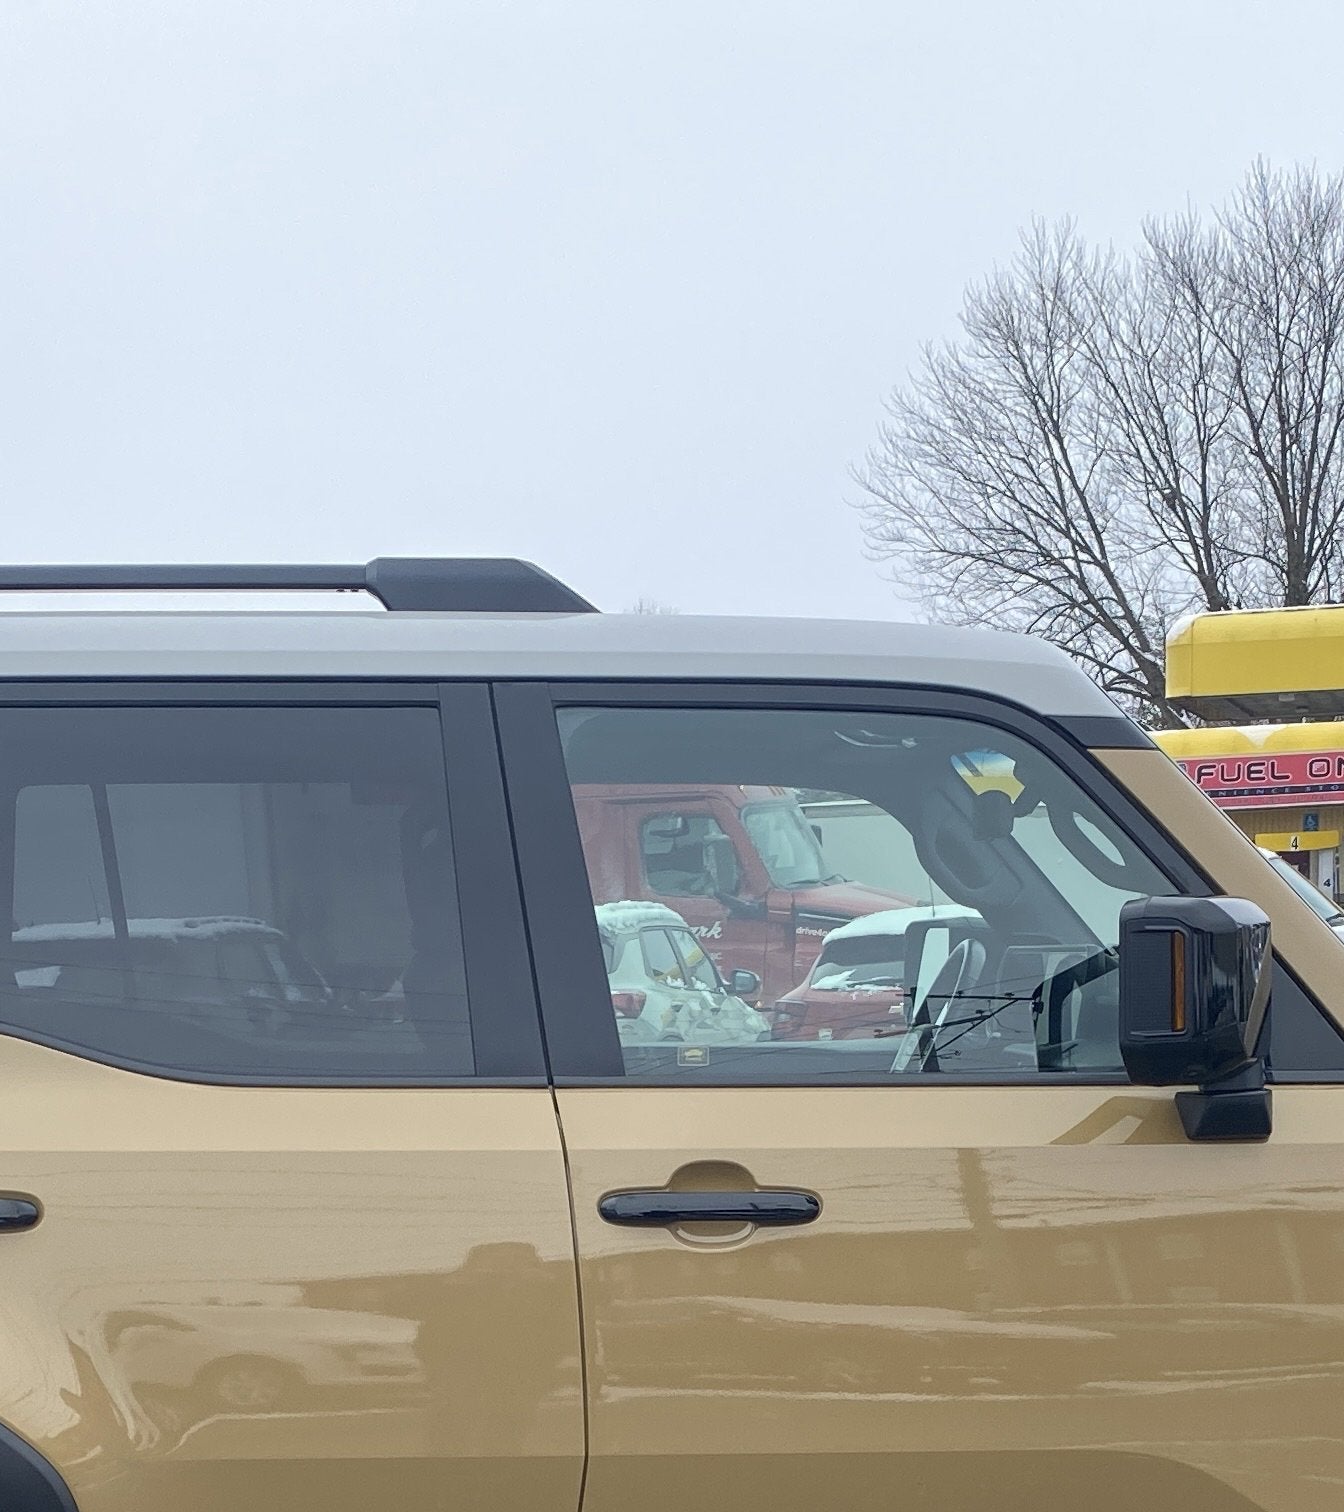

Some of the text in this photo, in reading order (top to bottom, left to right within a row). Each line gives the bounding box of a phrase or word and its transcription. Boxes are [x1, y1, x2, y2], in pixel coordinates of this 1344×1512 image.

[1196, 759, 1291, 784] FUEL
[1291, 836, 1298, 850] 4
[1323, 878, 1331, 887] 4
